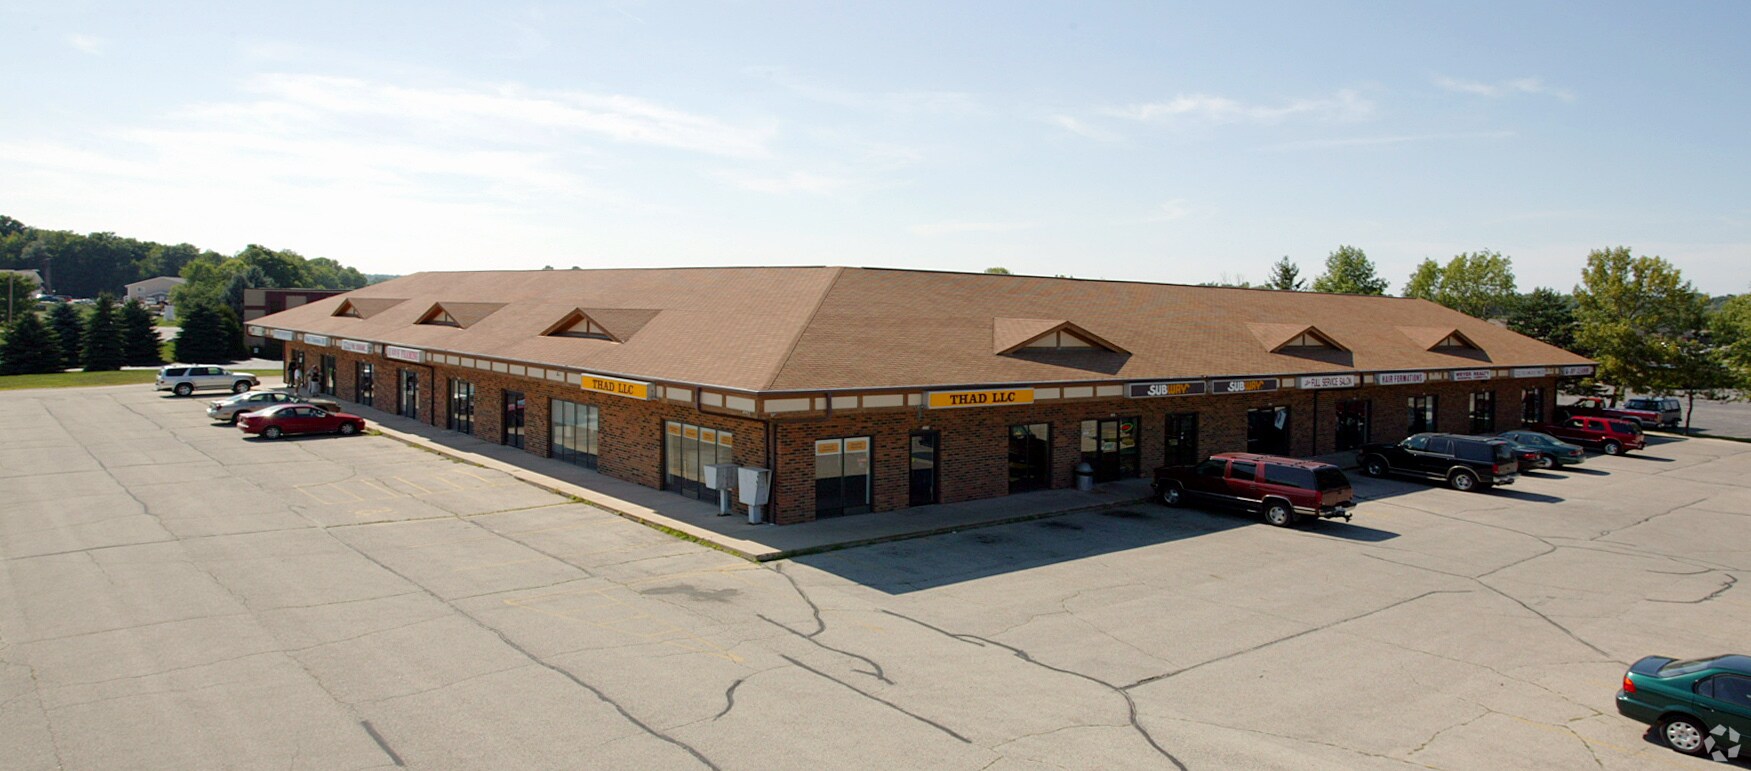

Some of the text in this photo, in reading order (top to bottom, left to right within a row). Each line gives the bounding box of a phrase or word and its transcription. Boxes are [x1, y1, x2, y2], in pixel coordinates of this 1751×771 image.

[592, 379, 634, 395] THAD LLC
[1147, 383, 1191, 396] SUBWAY
[1227, 380, 1265, 392] SUBWAY
[949, 392, 1016, 405] THAD LLC
